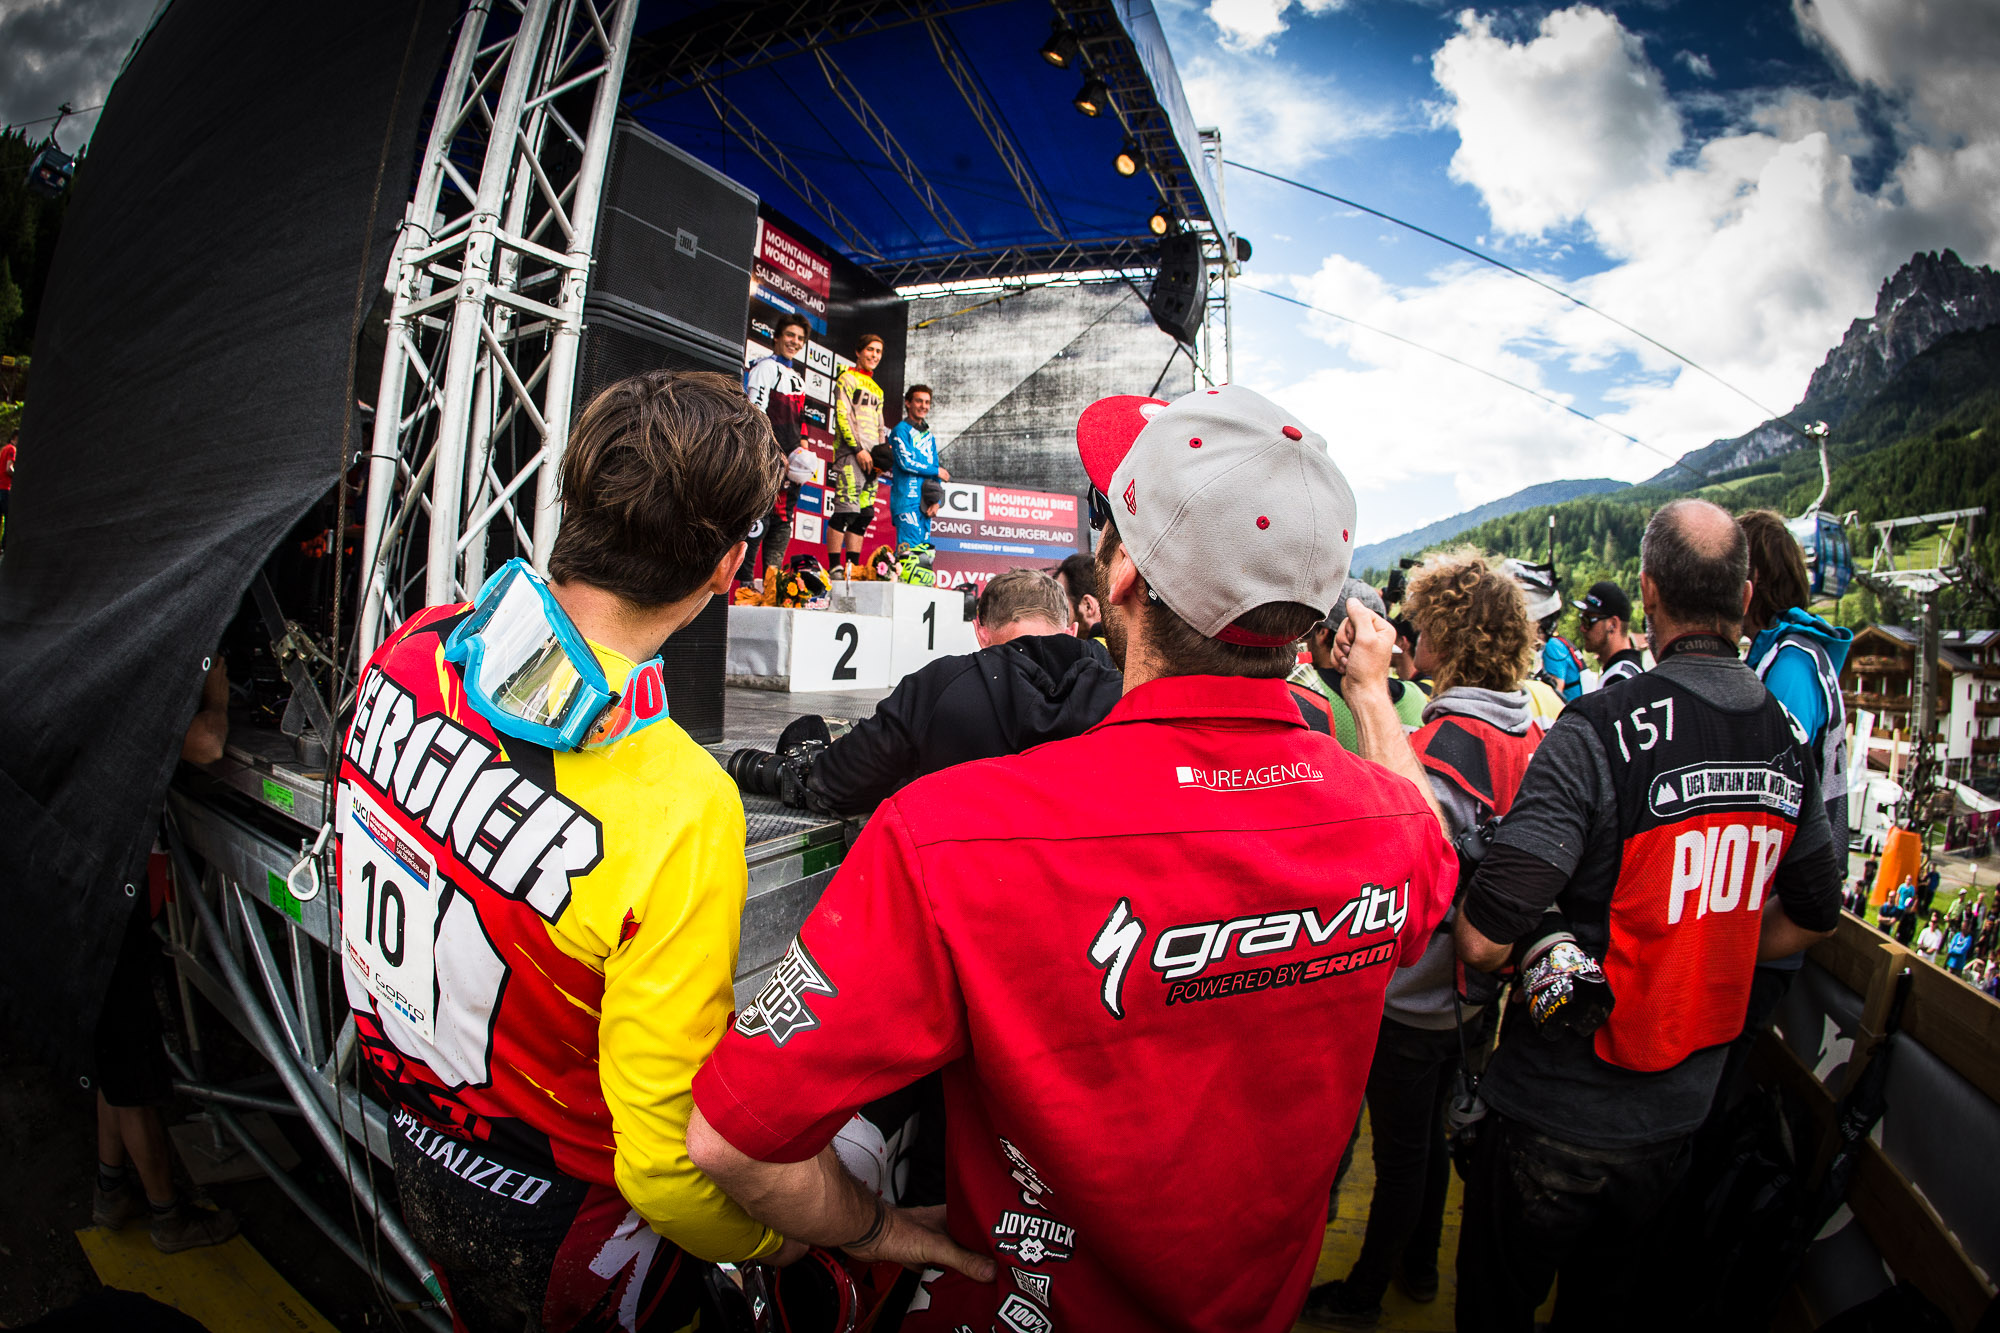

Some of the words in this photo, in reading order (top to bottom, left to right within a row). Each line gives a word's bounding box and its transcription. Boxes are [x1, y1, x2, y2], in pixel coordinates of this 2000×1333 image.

[764, 243, 796, 272] WORLD
[796, 264, 814, 281] CUP
[766, 229, 811, 266] MOUNTAIN
[811, 258, 829, 279] BIKE
[755, 264, 826, 313] SALZBURGERLAND
[813, 351, 831, 368] UCI
[988, 493, 1049, 510] MOUNTAIN
[1050, 496, 1074, 511] BIKE
[988, 505, 1030, 519] WORLD
[1031, 509, 1053, 521] CUP
[930, 520, 972, 534] OGANG
[980, 525, 1074, 543] SALZBURGERLAND
[921, 600, 937, 651] 1
[831, 622, 858, 681] 2
[1613, 697, 1674, 763] 157
[1746, 771, 1767, 792] BIK
[355, 799, 369, 823] UCI
[396, 840, 416, 860] LEOGANG
[396, 847, 429, 880] SALZBURGERLAND
[360, 860, 406, 969] 10
[1153, 877, 1410, 983] gravity
[1170, 969, 1272, 1001] POWERED
[1278, 965, 1302, 985] BY
[1304, 942, 1394, 979] SRAM
[375, 972, 425, 1021] GoPro
[393, 1110, 552, 1205] SPECIALIZED
[995, 1211, 1076, 1248] JOYSTICK
[1007, 1304, 1046, 1333] 100%
